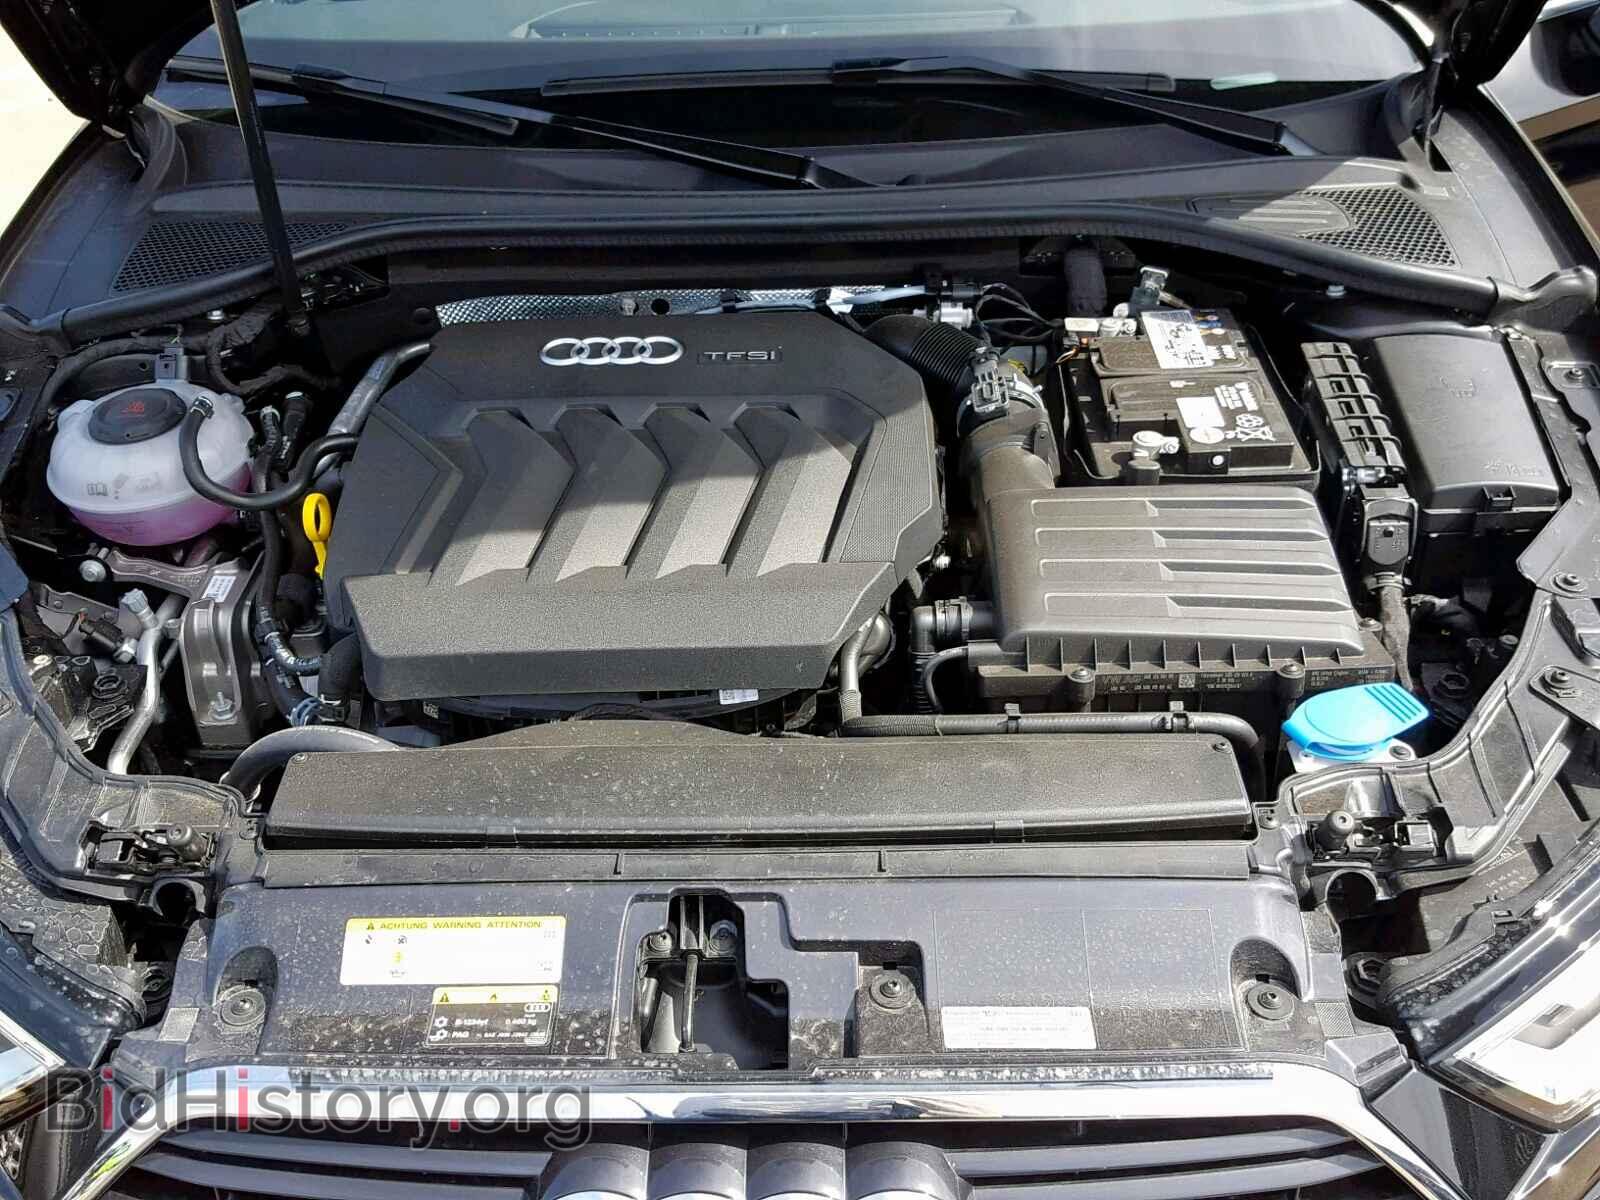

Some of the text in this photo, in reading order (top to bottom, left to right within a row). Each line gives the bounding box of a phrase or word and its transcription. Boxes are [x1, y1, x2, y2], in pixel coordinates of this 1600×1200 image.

[704, 351, 776, 360] TFSI
[380, 920, 542, 930] ACHTUNG WARNING ATTENTION
